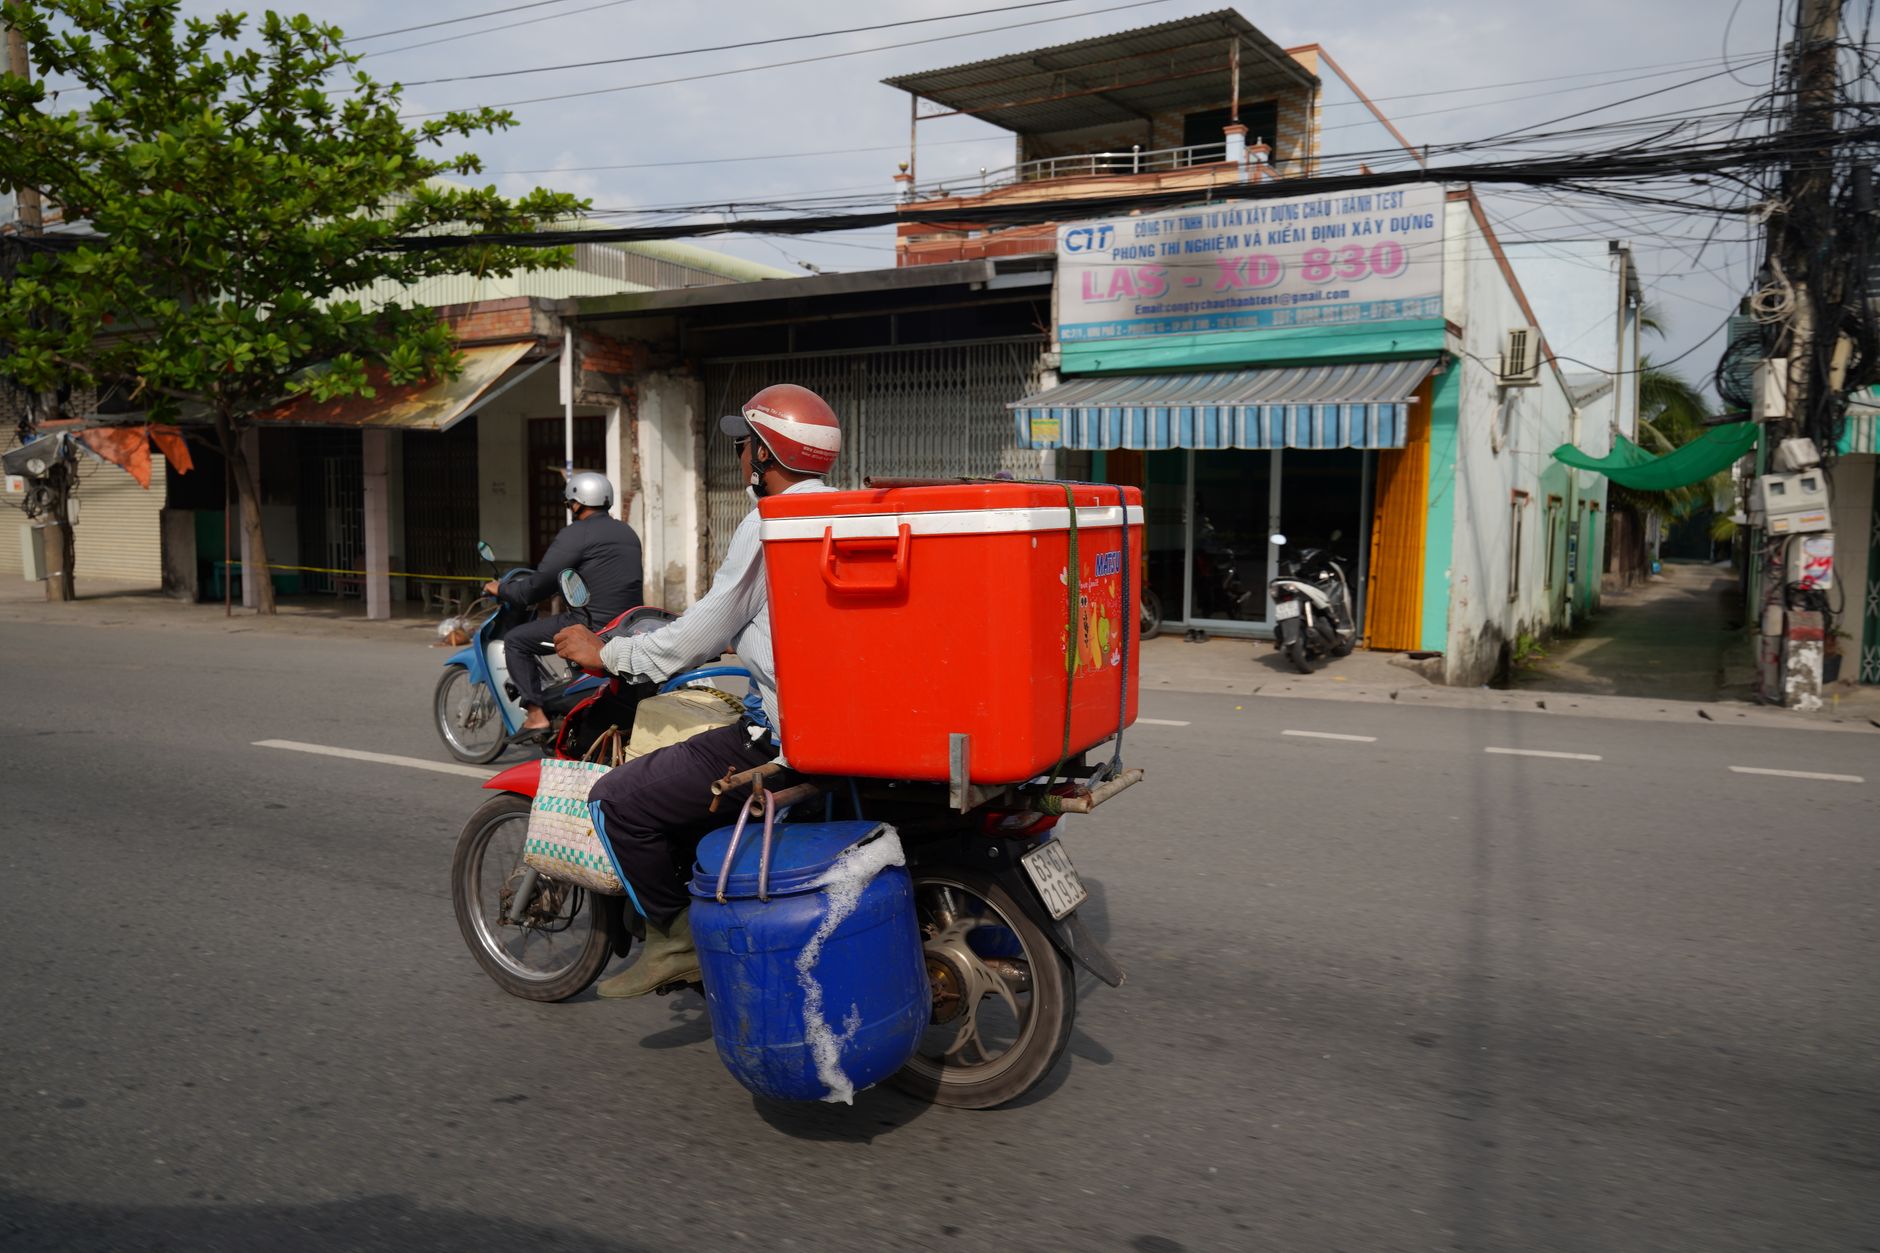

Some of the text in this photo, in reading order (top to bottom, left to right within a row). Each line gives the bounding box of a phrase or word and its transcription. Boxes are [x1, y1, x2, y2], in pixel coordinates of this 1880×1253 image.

[1163, 218, 1176, 233] TY
[1178, 215, 1203, 231] TNHH
[1246, 205, 1268, 225] XÂY
[1302, 198, 1331, 219] CHÂU
[1376, 190, 1405, 211] TEST
[1112, 243, 1155, 261] PHÒNG
[1184, 234, 1238, 254] NGHIỆM
[1243, 230, 1262, 248] VÀ
[1311, 223, 1346, 243] ĐỊNH
[1352, 217, 1385, 237] XÂY
[1390, 213, 1434, 236] DỰNG
[1081, 264, 1168, 302] LAS
[1214, 253, 1285, 292] XD
[1301, 239, 1408, 283] 830
[1095, 550, 1121, 577] MATSU
